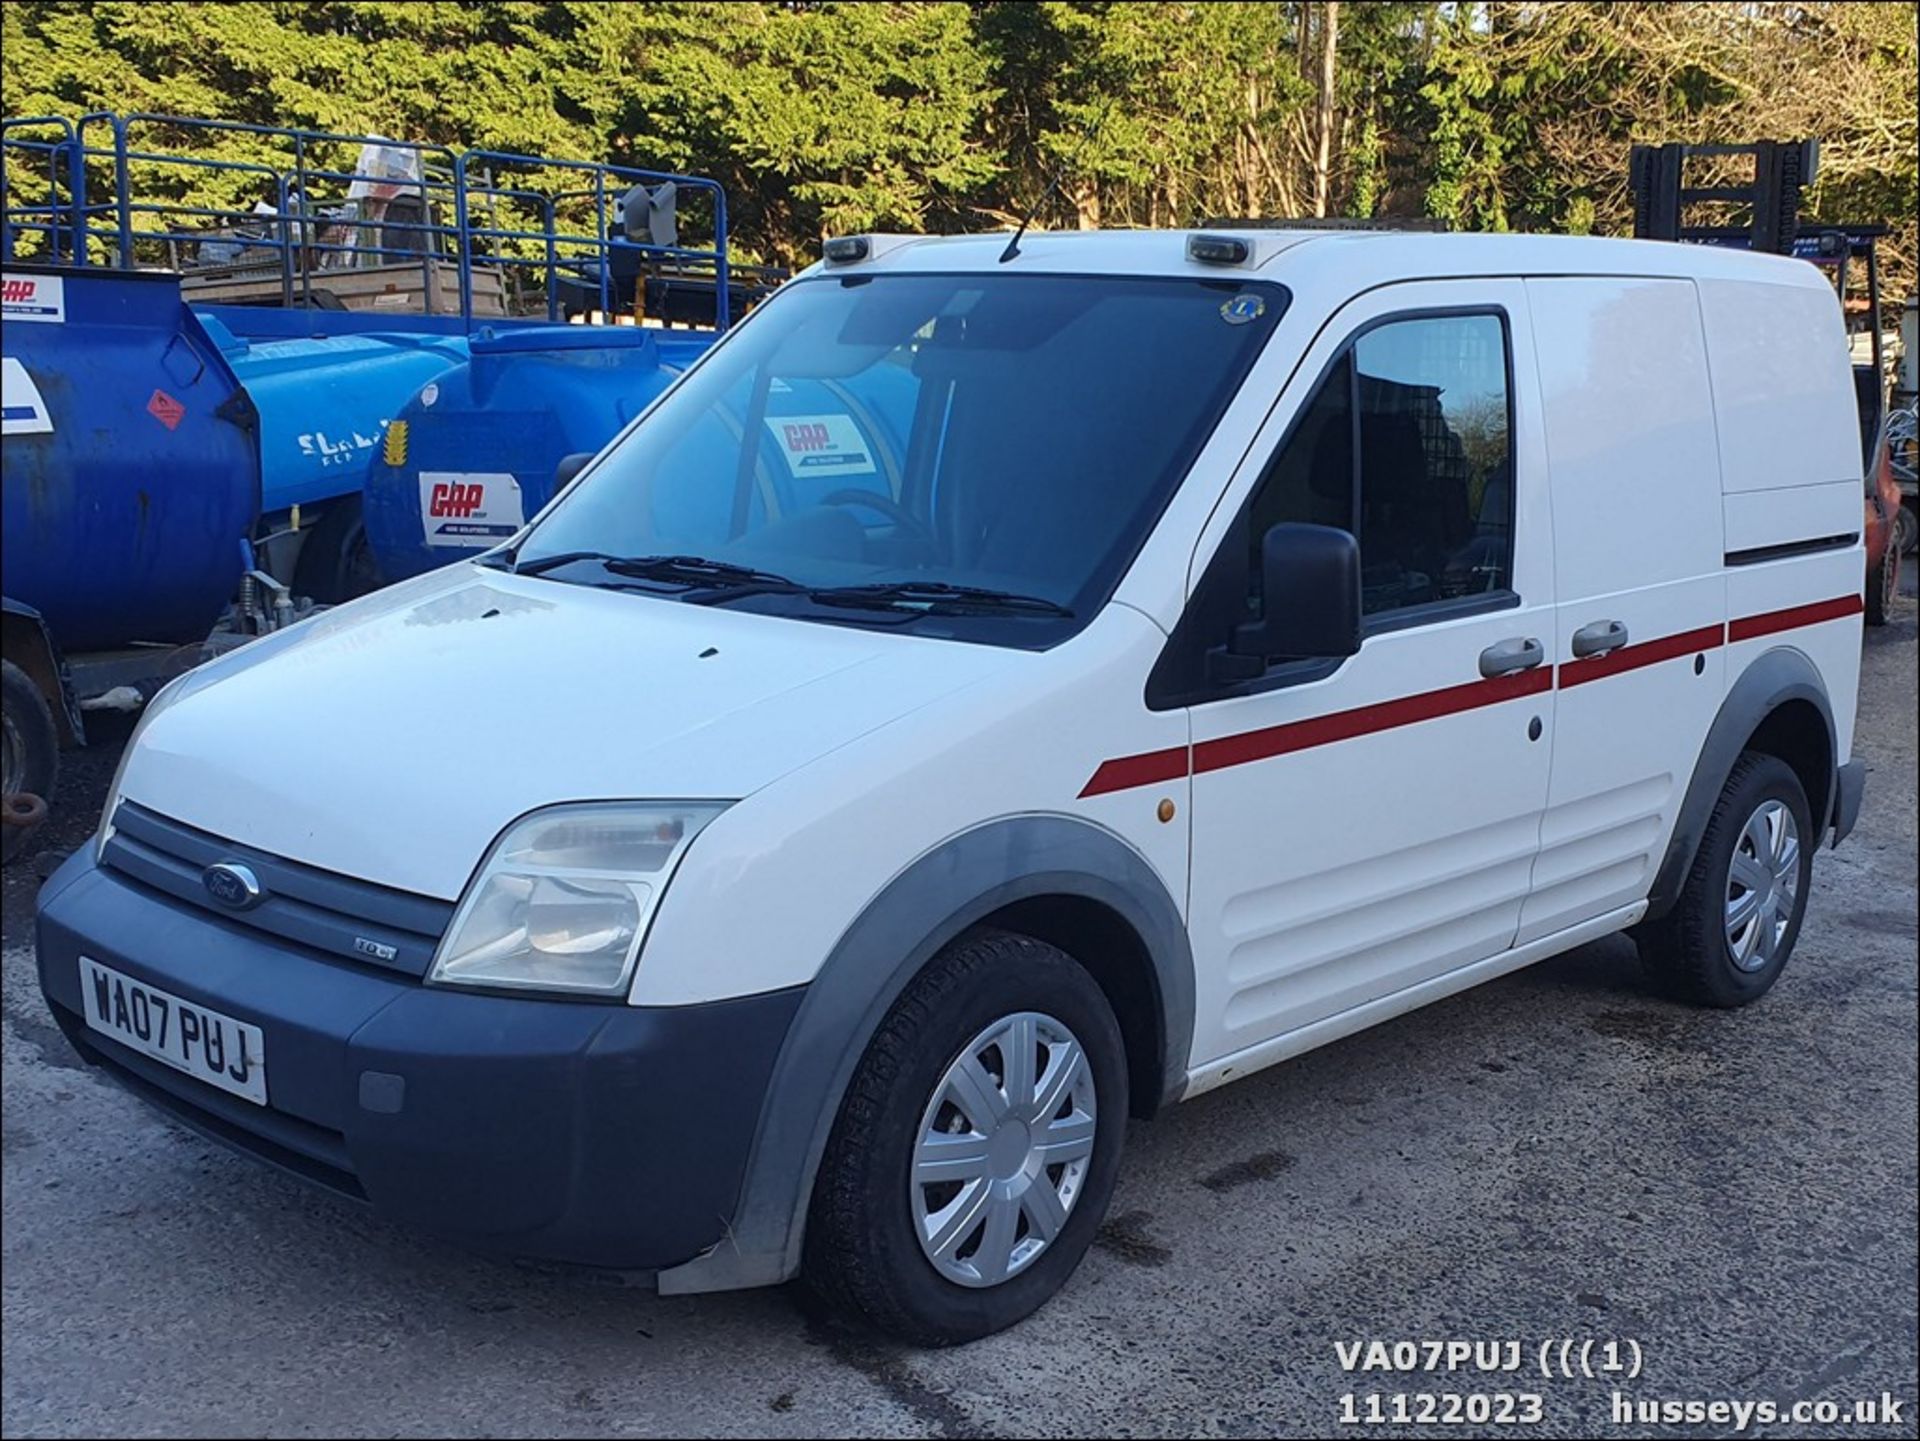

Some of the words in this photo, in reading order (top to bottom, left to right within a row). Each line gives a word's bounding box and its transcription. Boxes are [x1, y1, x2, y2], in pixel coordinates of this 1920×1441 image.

[783, 423, 830, 452] GAP
[430, 483, 484, 517] GAP
[209, 871, 240, 899] Ford
[91, 967, 169, 1050] WA07
[178, 1005, 249, 1084] PUJ
